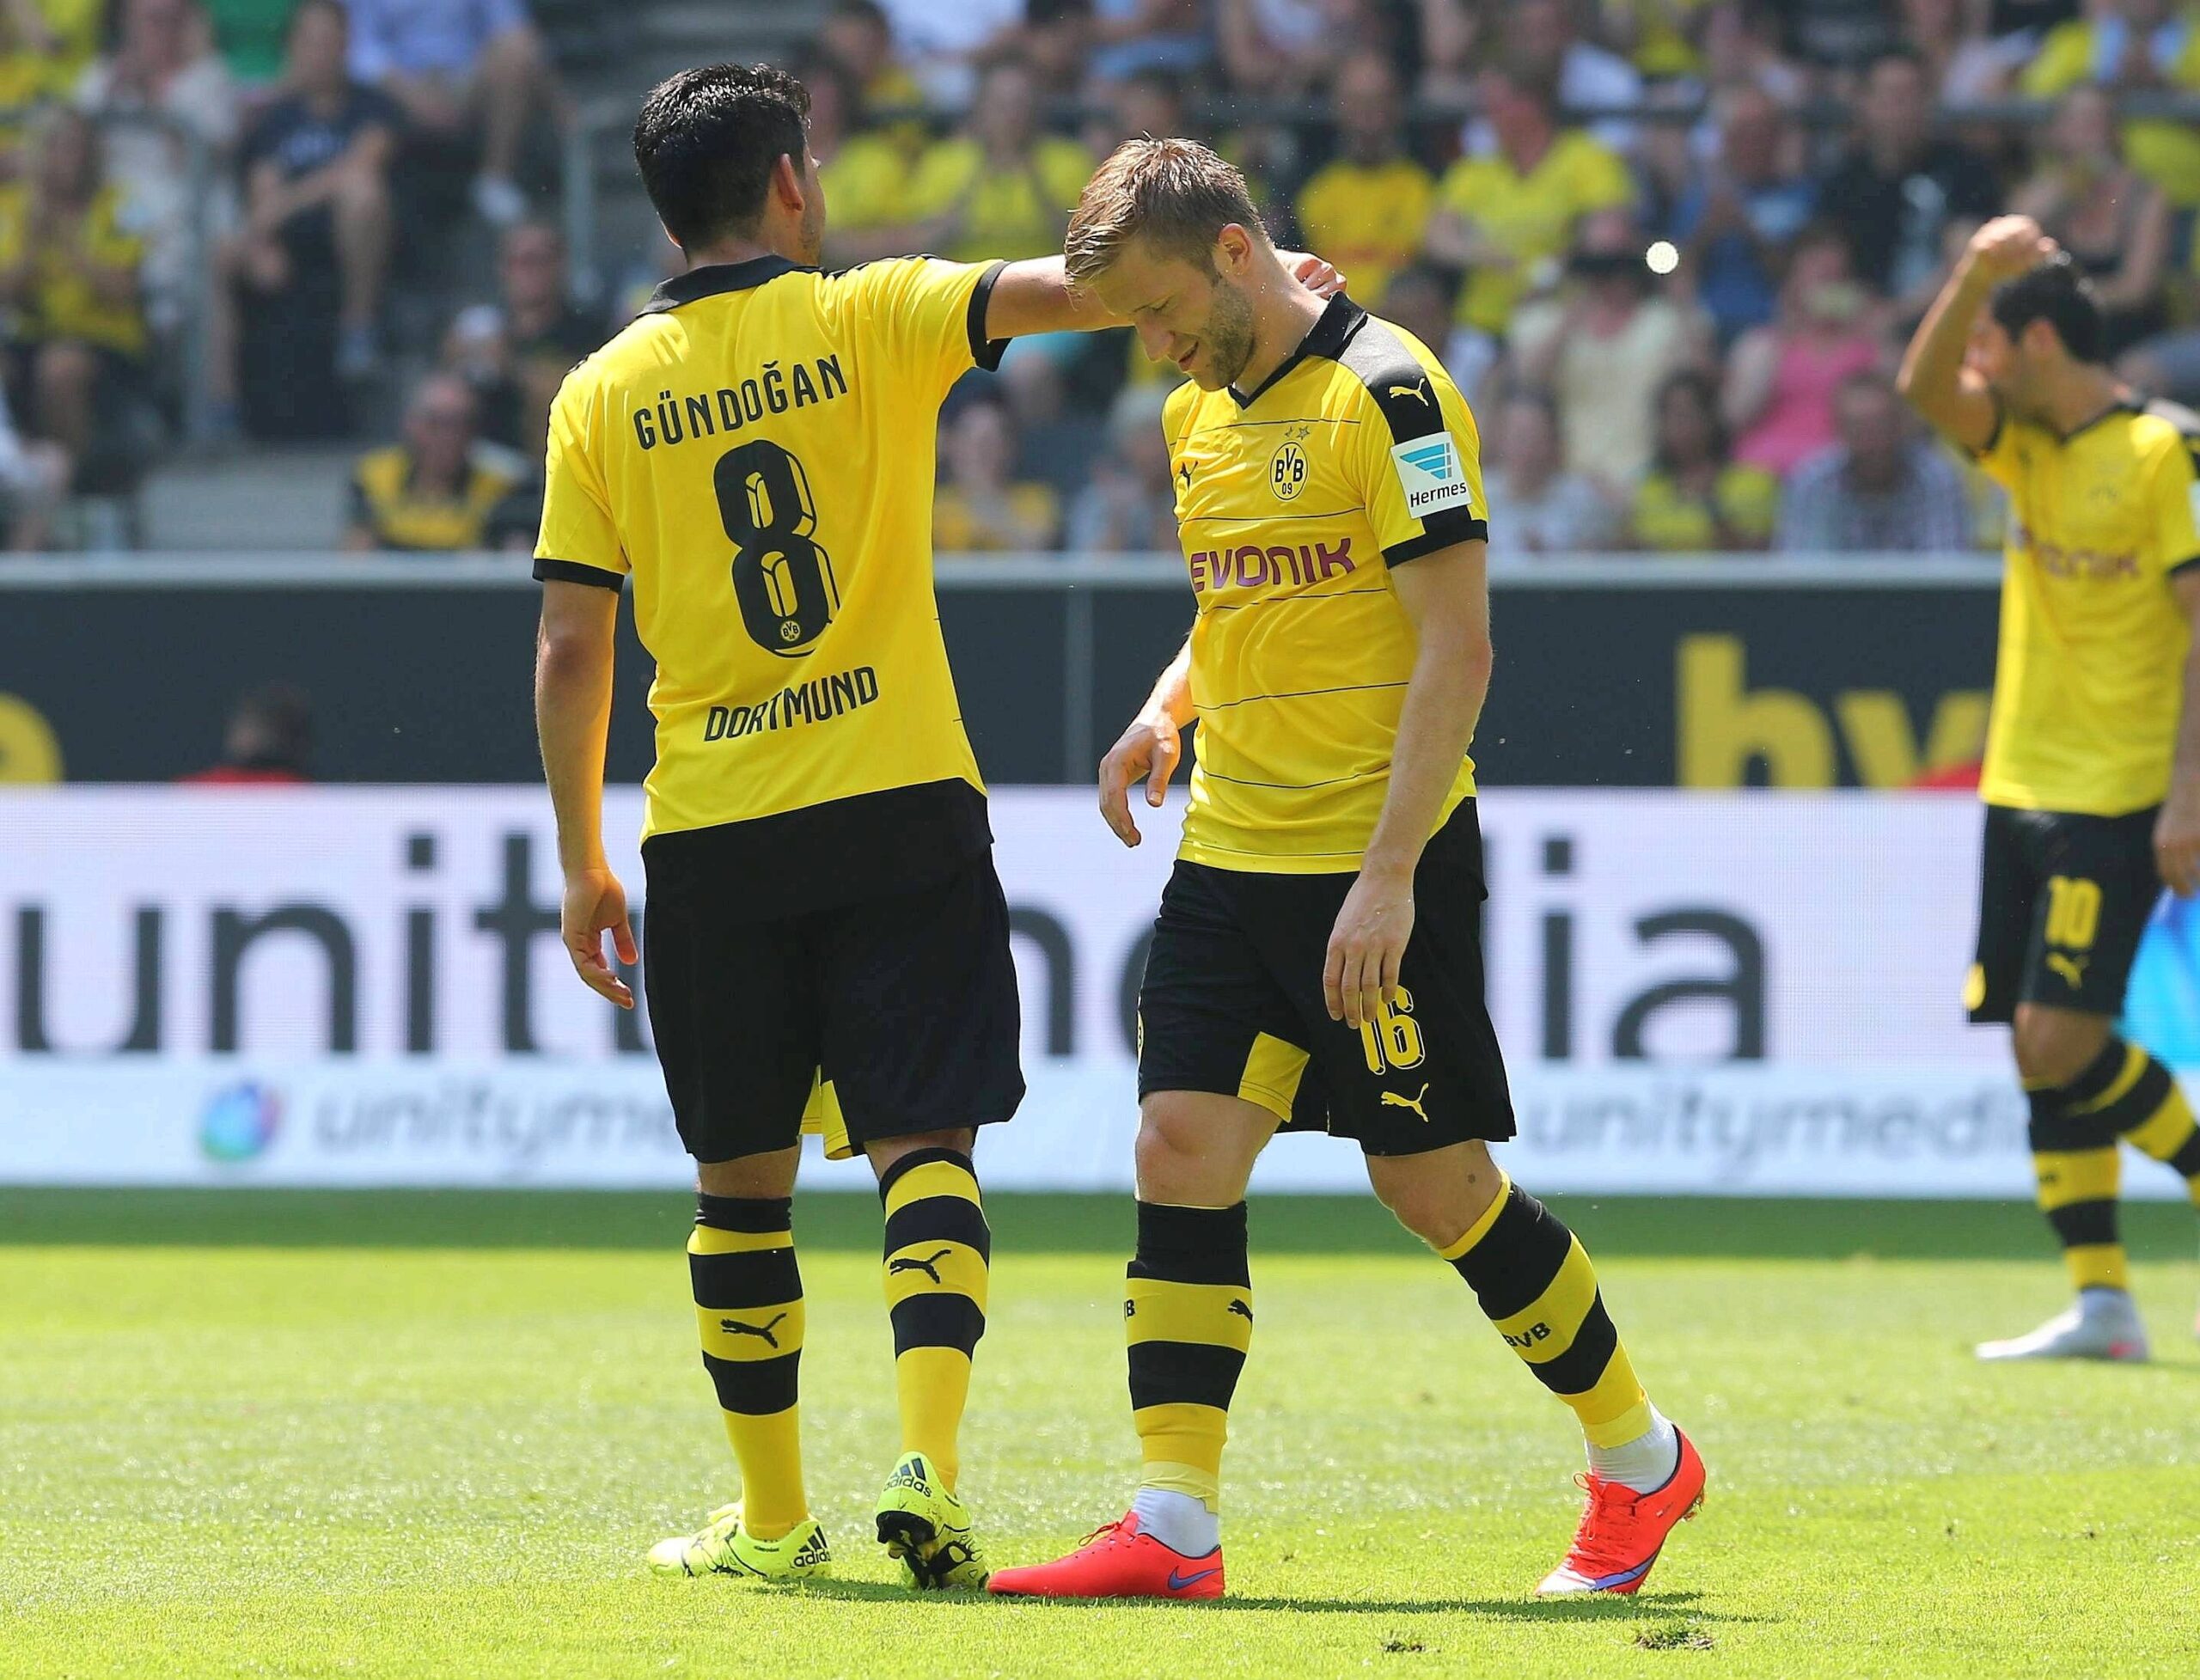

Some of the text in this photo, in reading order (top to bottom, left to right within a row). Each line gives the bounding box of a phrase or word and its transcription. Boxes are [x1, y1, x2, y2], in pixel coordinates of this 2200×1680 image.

[633, 353, 848, 450] GÜNDOĞAN
[1274, 448, 1304, 482] BVB
[1410, 481, 1467, 508] Hermes
[712, 439, 840, 658] 8
[703, 666, 880, 742] DORTMUND
[2044, 874, 2103, 950] 10
[1360, 985, 1426, 1076] 16
